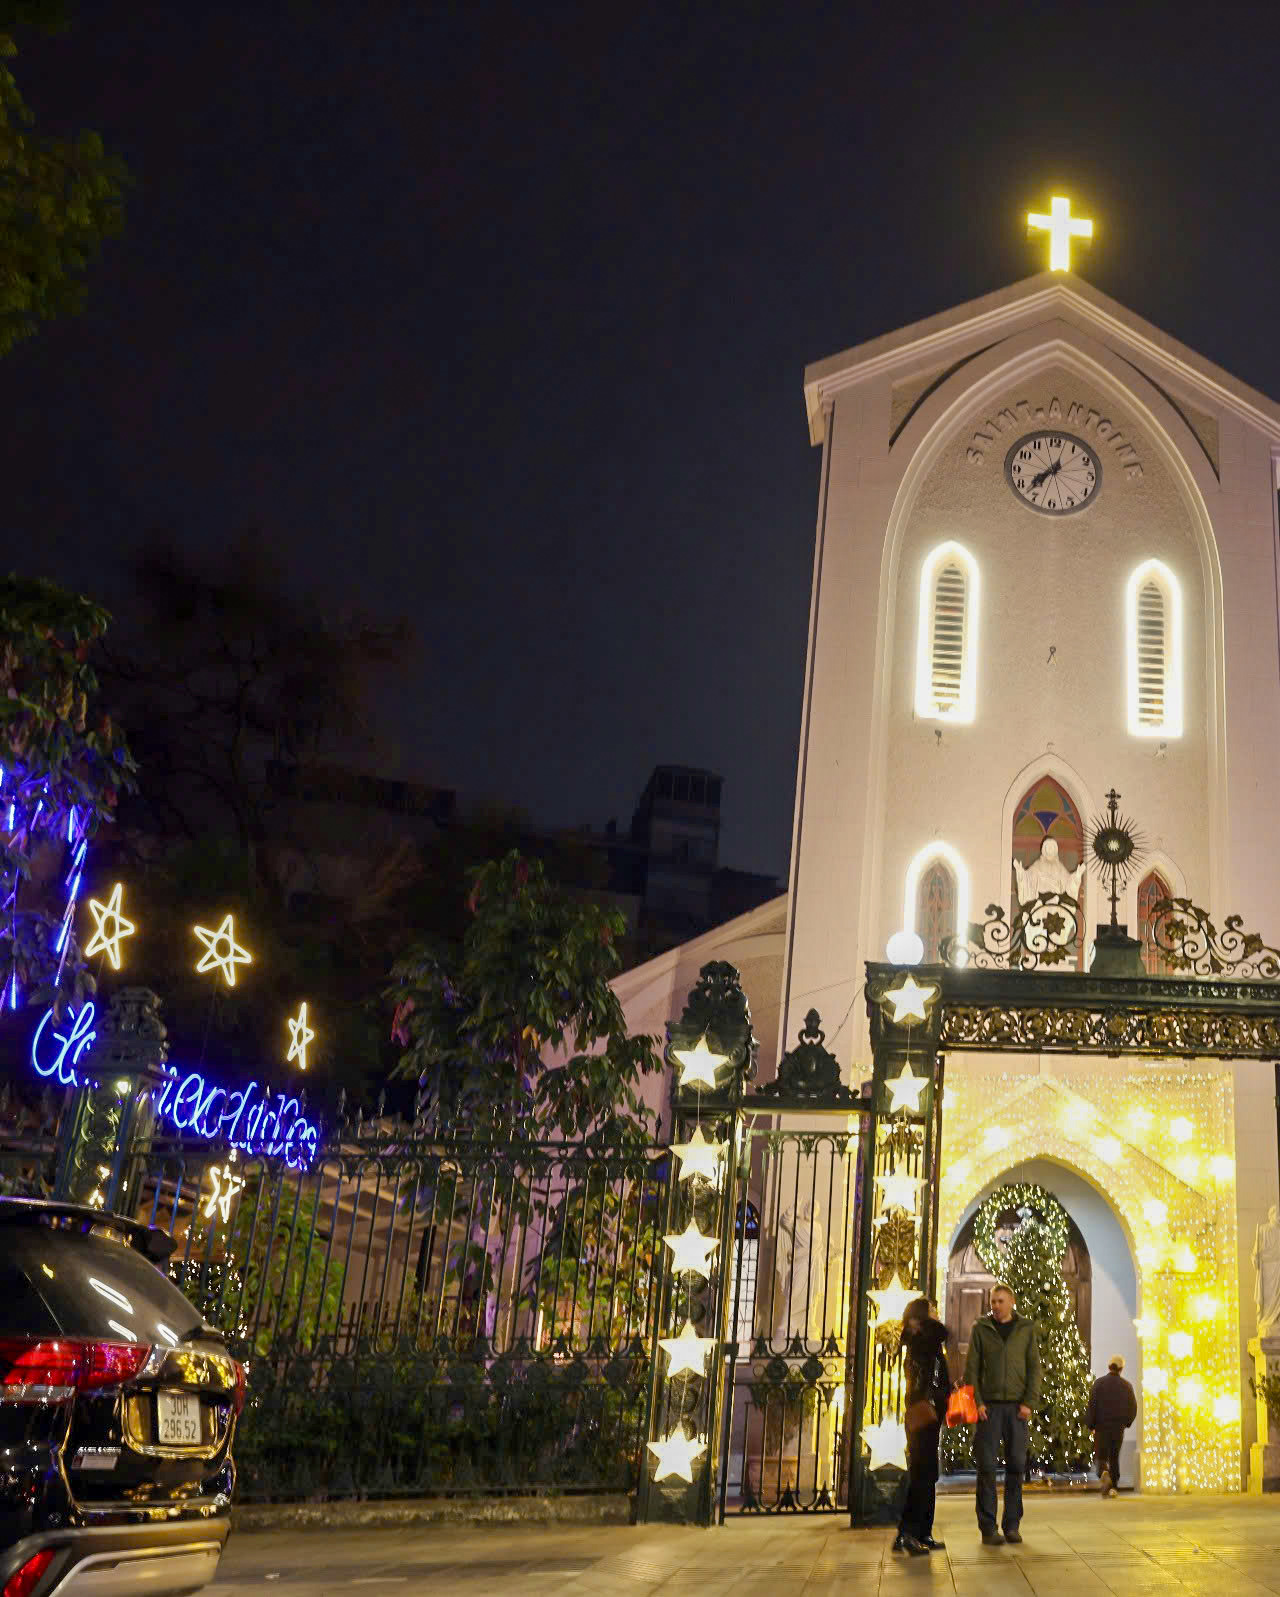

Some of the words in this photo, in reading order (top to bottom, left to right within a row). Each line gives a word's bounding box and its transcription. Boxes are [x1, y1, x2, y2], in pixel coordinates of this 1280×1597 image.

[1049, 438, 1062, 449] 12
[1019, 450, 1032, 461] 10
[163, 1418, 197, 1440] 296.52
